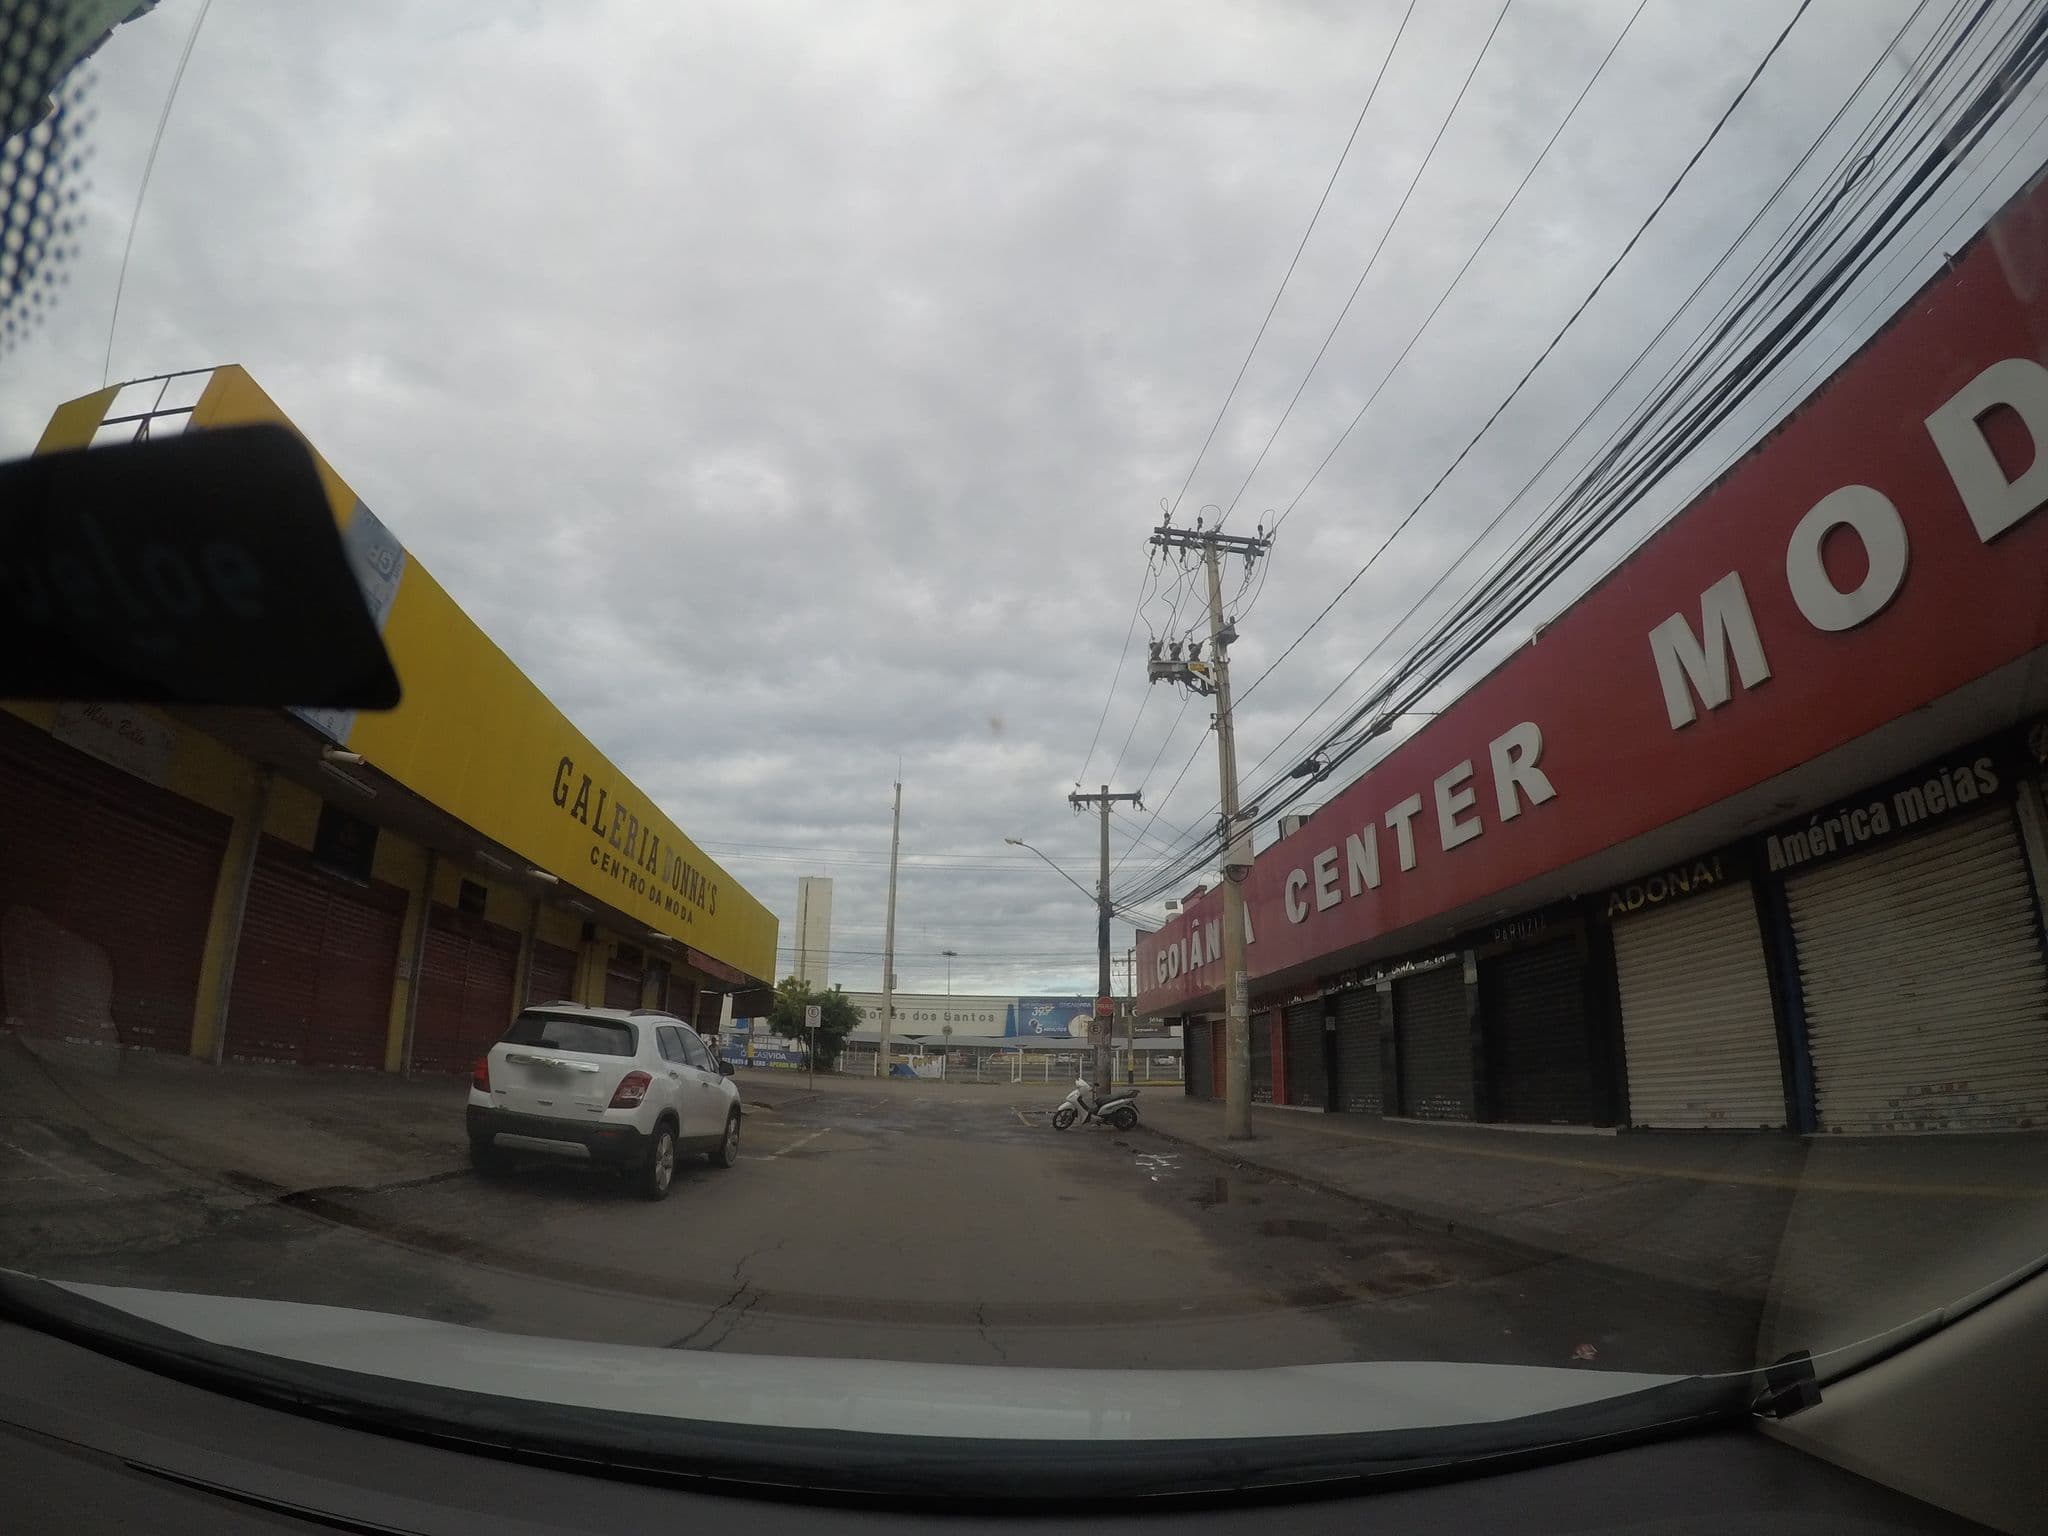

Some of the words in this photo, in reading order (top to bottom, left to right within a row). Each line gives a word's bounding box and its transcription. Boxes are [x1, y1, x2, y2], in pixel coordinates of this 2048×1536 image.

[552, 756, 660, 876] GALERIA
[661, 843, 718, 917] DONNA'S
[1285, 721, 1558, 924] CENTER
[1767, 800, 1891, 874] América
[1895, 755, 1999, 830] meias
[590, 846, 646, 896] CENTRO
[647, 886, 664, 908] DA
[664, 894, 694, 926] MODA
[1608, 856, 1725, 917] ADONAI
[768, 1052, 787, 1060] VIDA
[913, 1011, 937, 1021] dos
[944, 1011, 995, 1022] Santos
